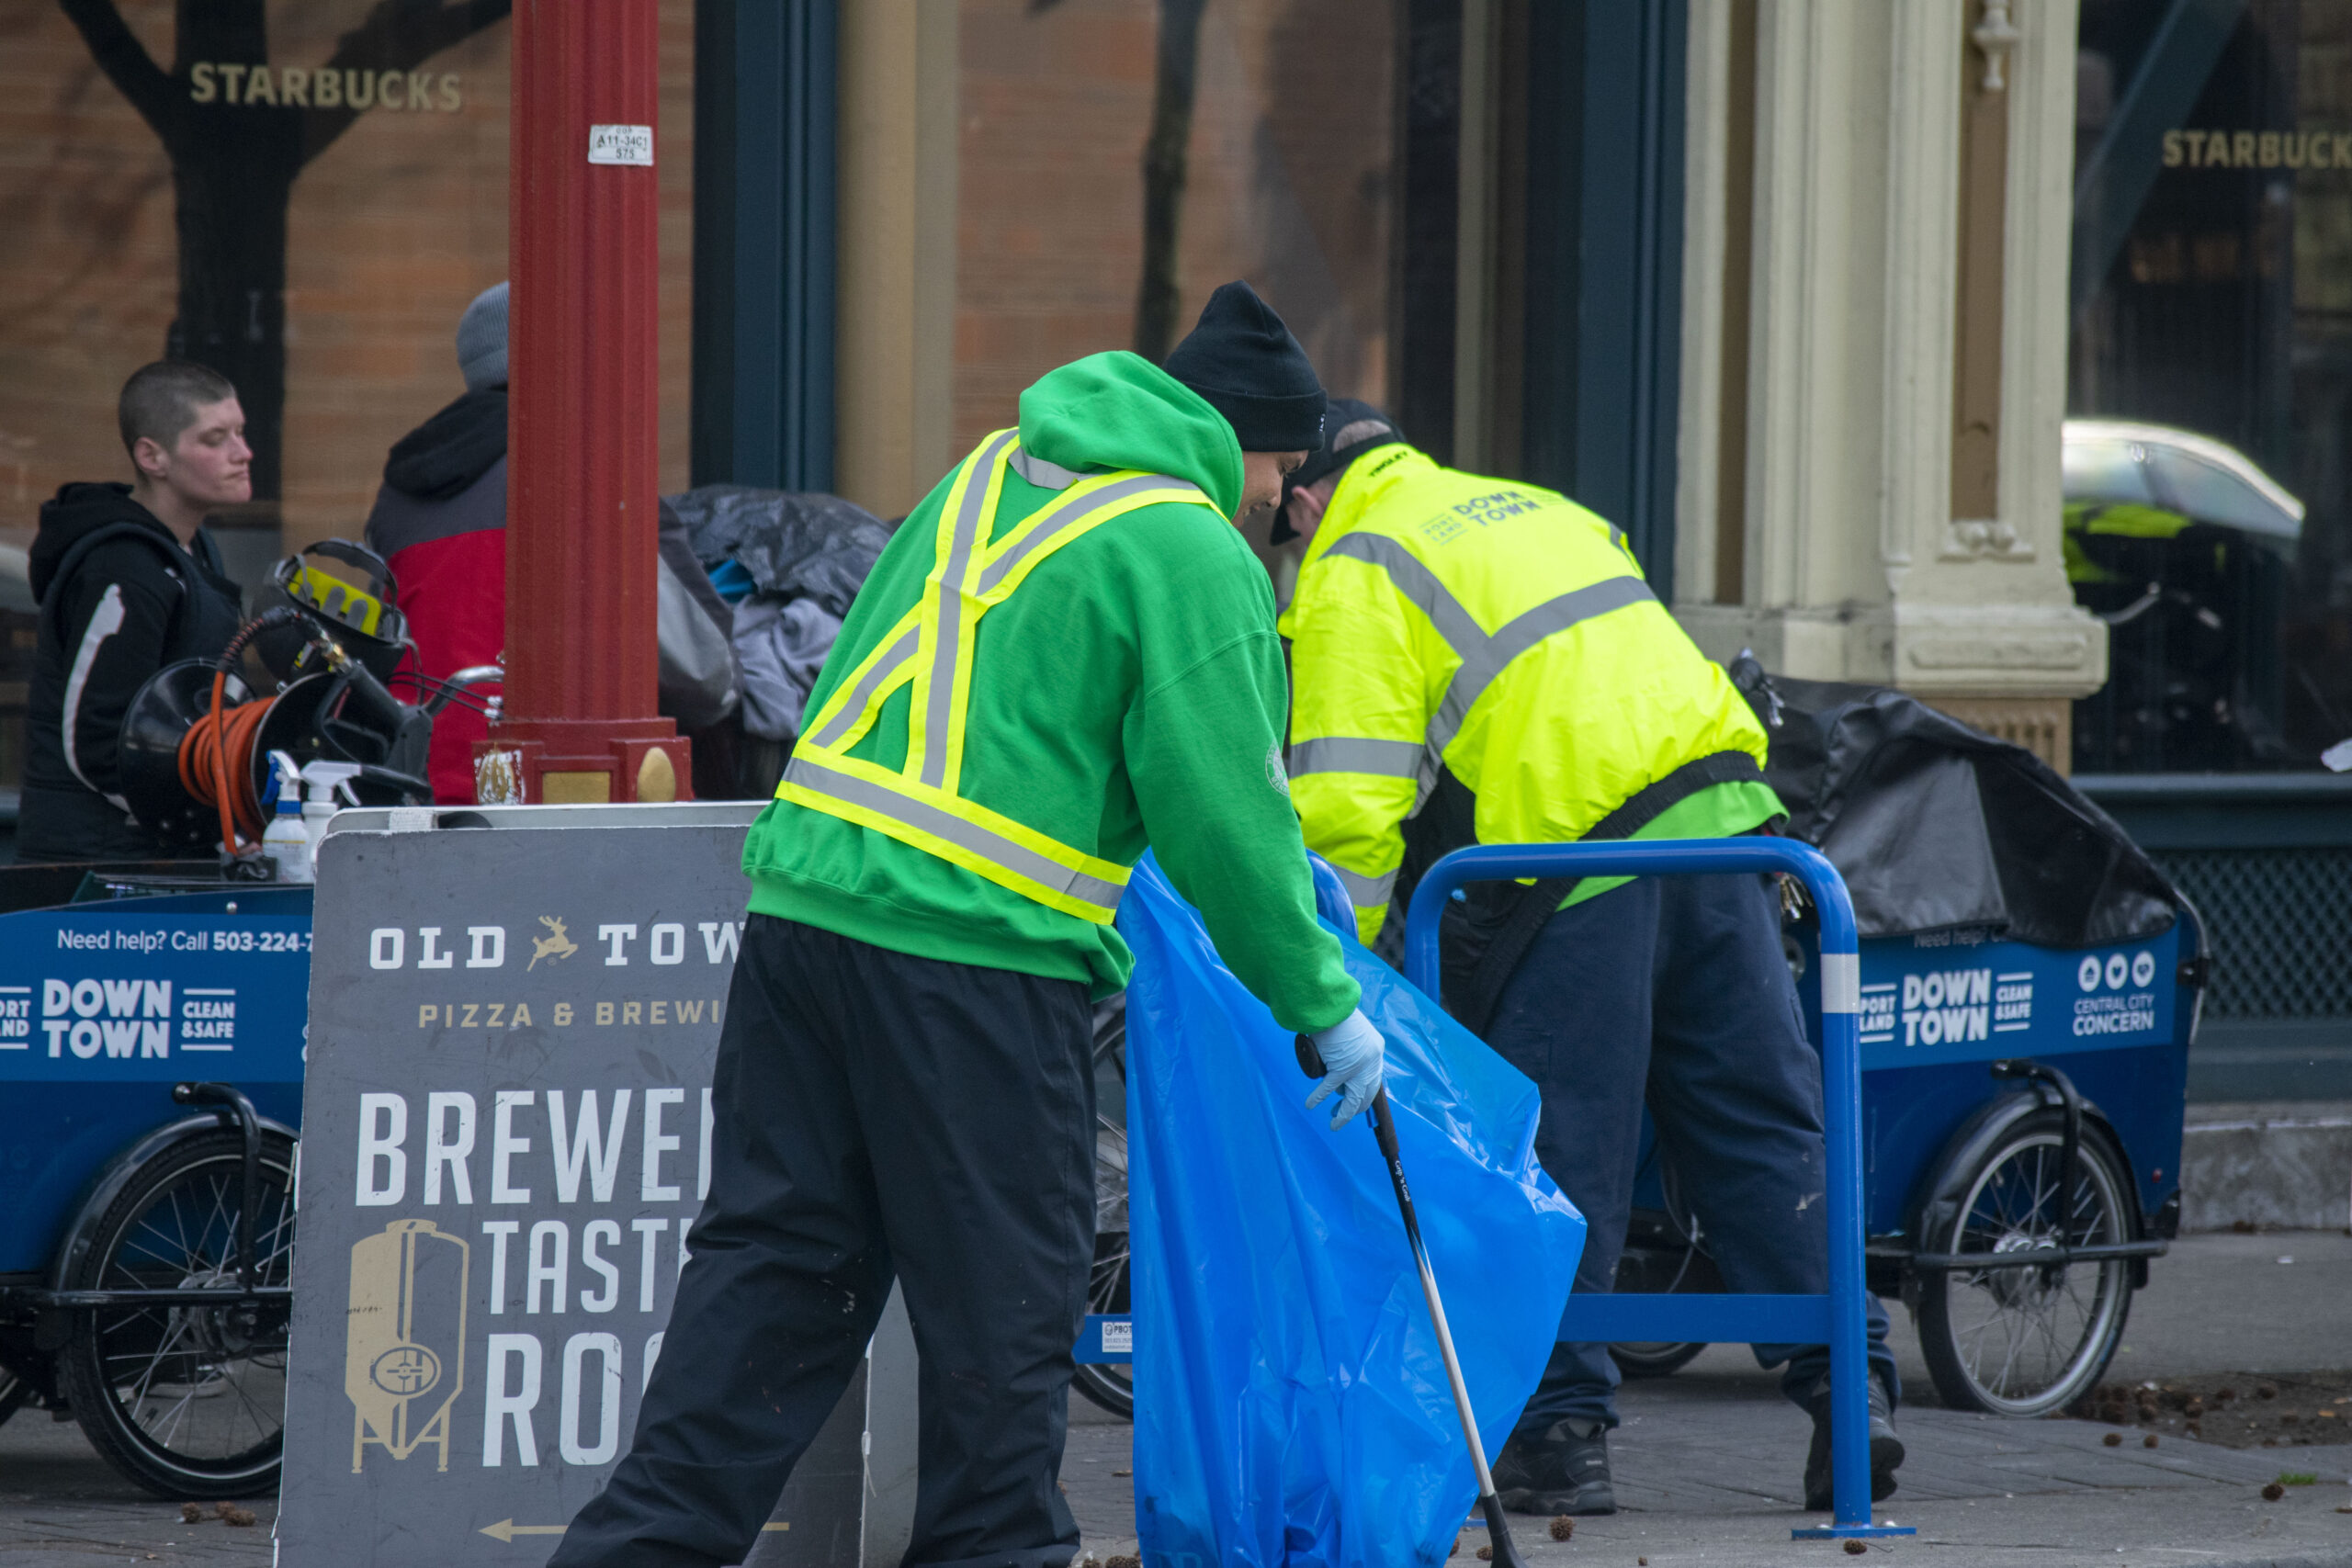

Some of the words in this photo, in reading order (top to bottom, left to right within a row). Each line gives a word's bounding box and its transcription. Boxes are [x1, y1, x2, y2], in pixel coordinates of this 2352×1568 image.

[190, 62, 460, 111] STARBUCKS
[2162, 130, 2352, 169] STARBUCK
[1452, 491, 1523, 515] DOWN
[1467, 501, 1543, 527] TOWN
[57, 930, 110, 950] Need
[116, 930, 167, 954] help?
[171, 931, 209, 951] Call
[369, 926, 505, 970] OLD
[598, 921, 746, 966] TOW
[42, 978, 172, 1018] DOWN
[1902, 968, 1991, 1010] DOWN
[1996, 984, 2032, 1003] CLEAN
[182, 1001, 235, 1019] CLEAN
[418, 1003, 533, 1028] PIZZA
[553, 1002, 574, 1027] &
[595, 999, 719, 1026] BREWI
[2074, 996, 2127, 1015] CENTRAL
[2127, 993, 2154, 1010] CITY
[0, 1020, 30, 1037] ND
[181, 1021, 234, 1039] &SAFE
[1901, 1005, 1990, 1046] TOWN
[2073, 1010, 2154, 1037] CONCERN
[42, 1020, 170, 1059] TOWN
[482, 1332, 667, 1467] RO
